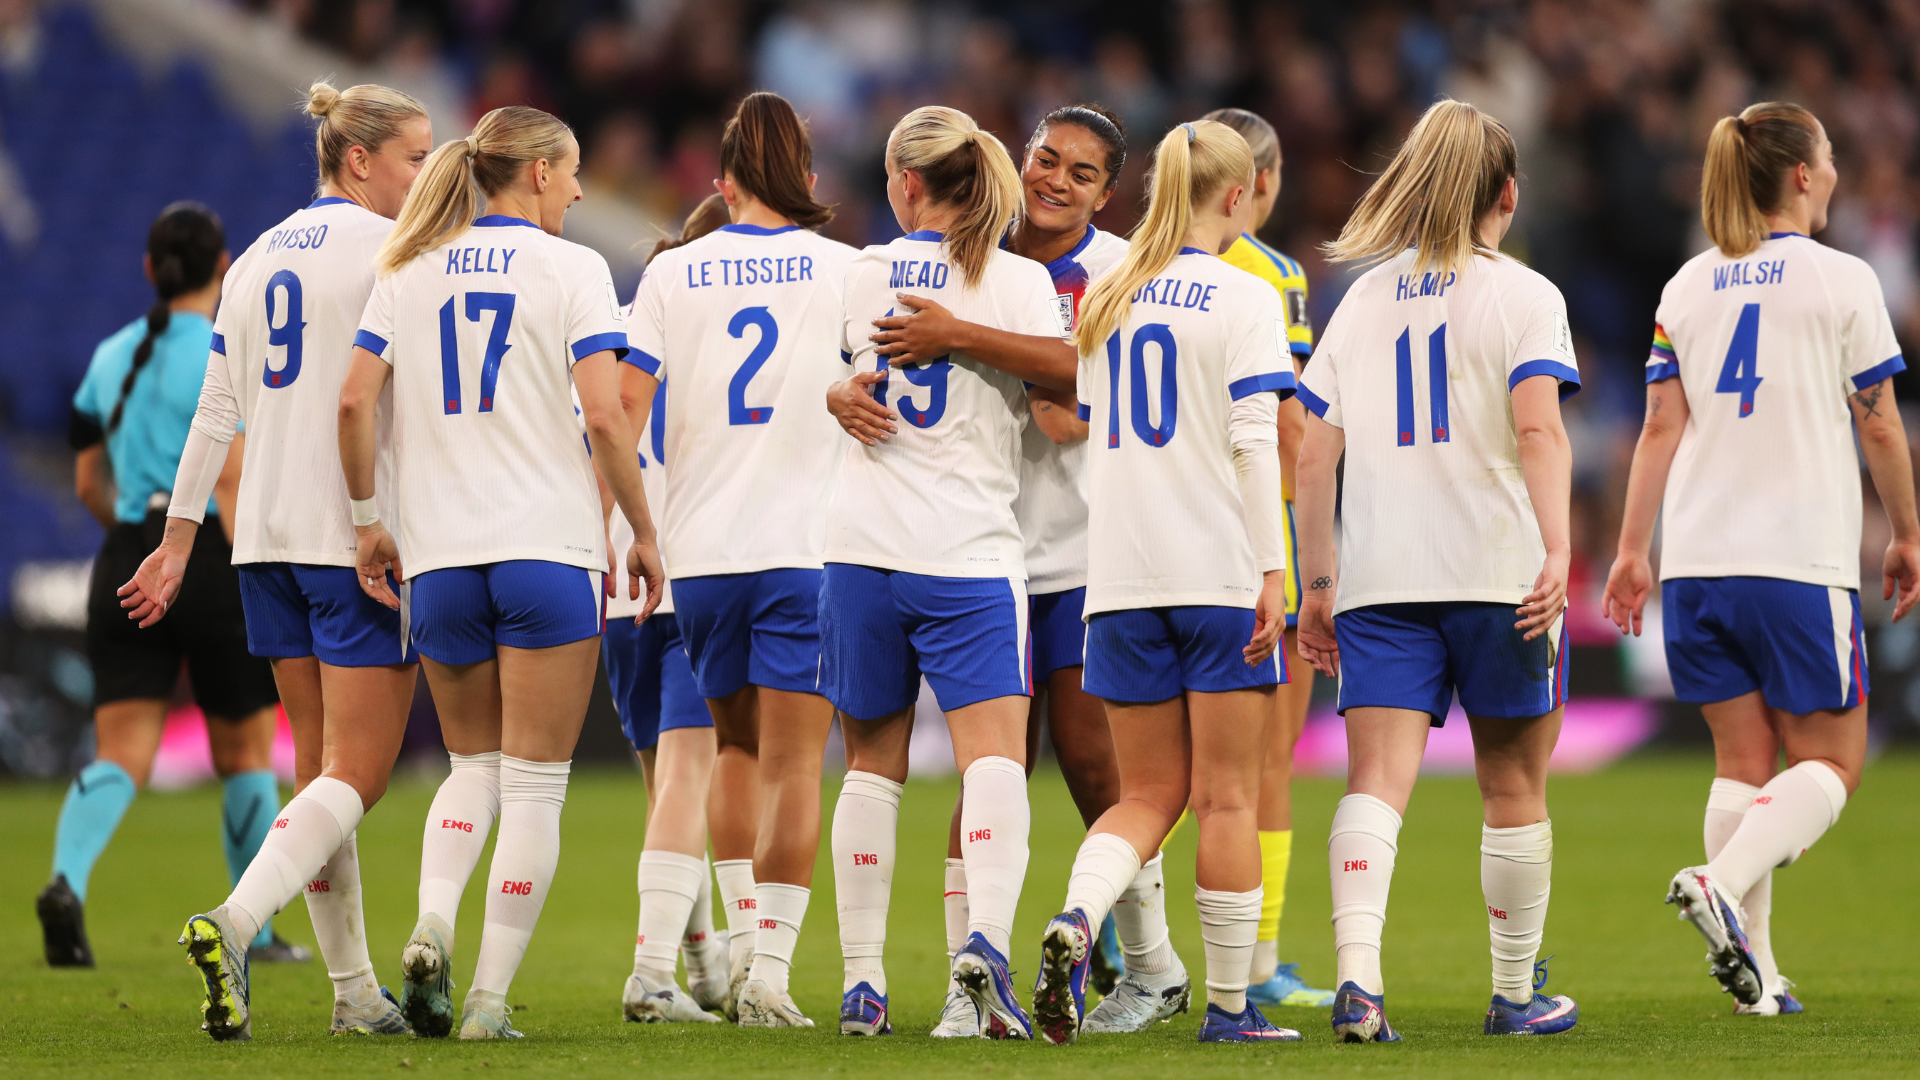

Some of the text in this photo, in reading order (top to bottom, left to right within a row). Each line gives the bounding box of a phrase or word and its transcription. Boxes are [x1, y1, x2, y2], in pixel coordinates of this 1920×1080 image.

[267, 224, 328, 254] RUSSO
[446, 248, 516, 274] KELLY
[688, 256, 813, 288] LE TISSIER
[889, 260, 949, 289] MEAD
[1714, 260, 1785, 291] WALSH
[1396, 271, 1456, 301] HEMP
[263, 269, 307, 389] 9
[439, 292, 516, 415] 17
[727, 306, 774, 426] 2
[1715, 303, 1764, 418] 4
[1106, 323, 1177, 449] 10
[1396, 321, 1450, 447] 11
[442, 819, 474, 833] ENG
[969, 829, 991, 843] ENG
[853, 853, 878, 866] ENG
[1344, 859, 1368, 872] ENG
[307, 879, 330, 893] ENG
[501, 880, 533, 896] ENG
[738, 898, 757, 911] ENG
[1487, 905, 1508, 920] ENG
[758, 918, 777, 930] ENG
